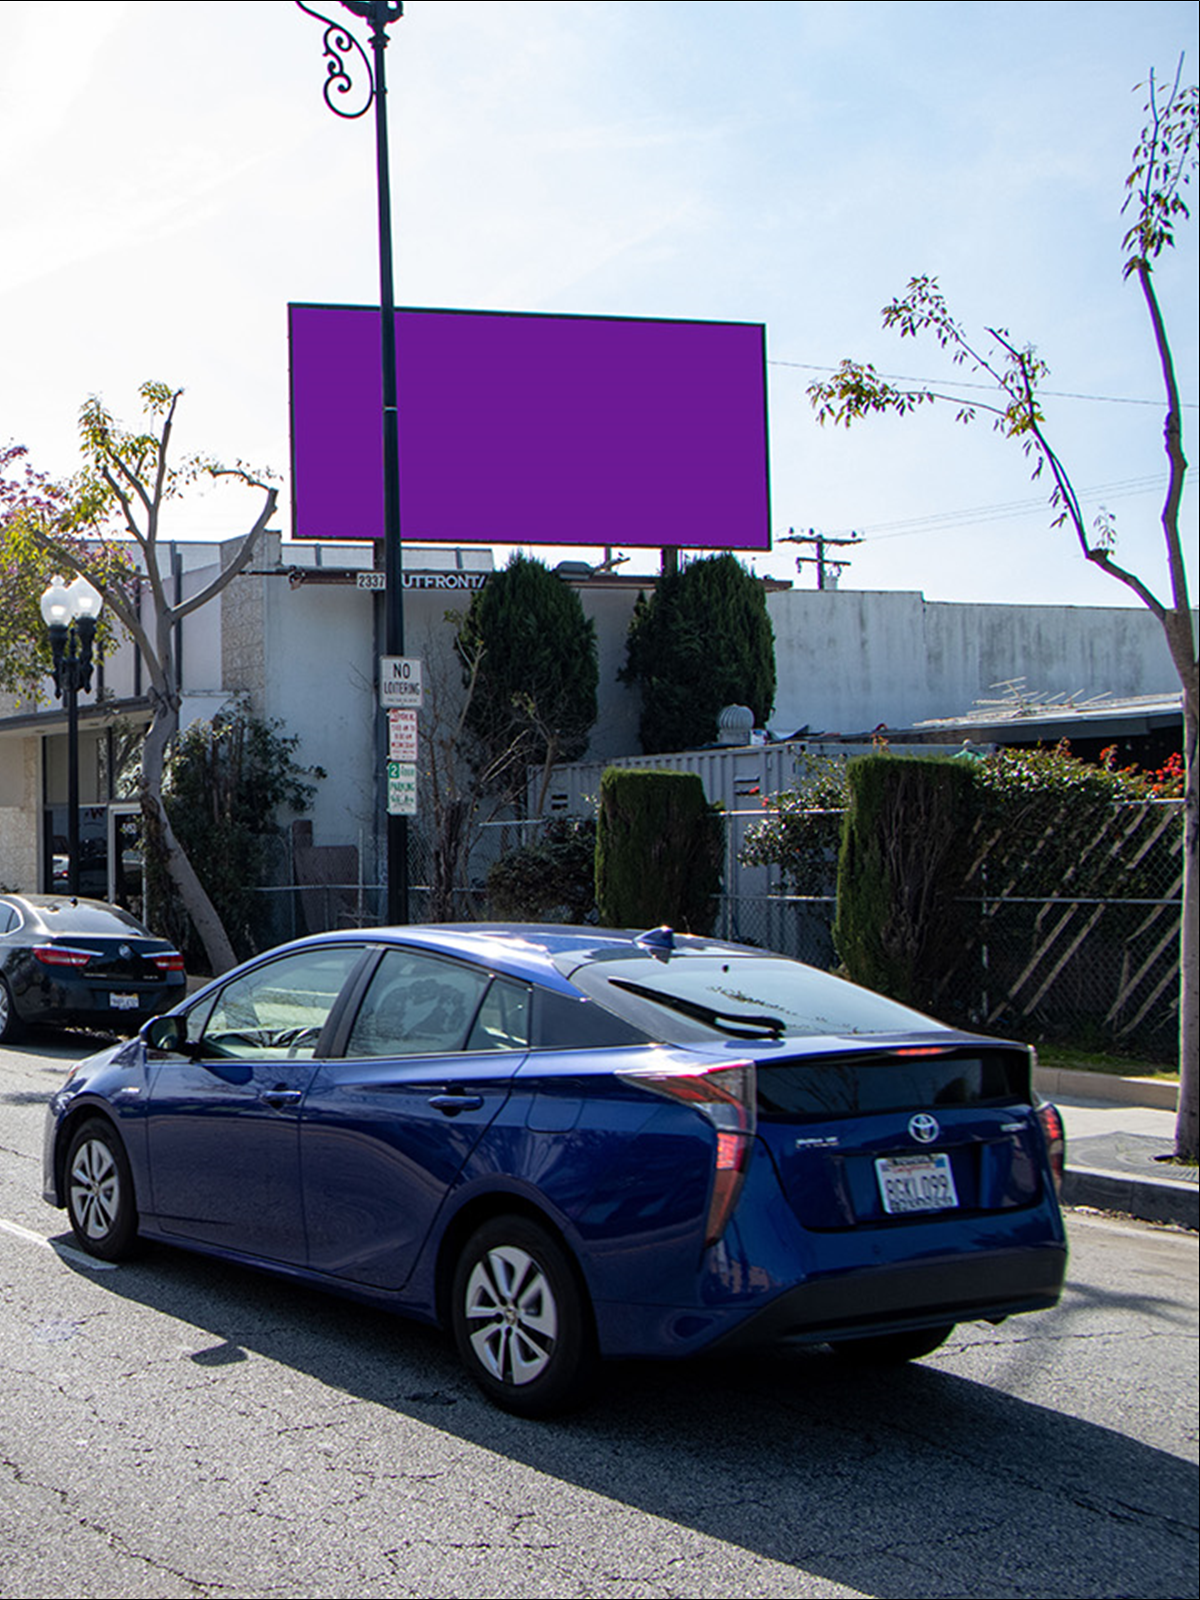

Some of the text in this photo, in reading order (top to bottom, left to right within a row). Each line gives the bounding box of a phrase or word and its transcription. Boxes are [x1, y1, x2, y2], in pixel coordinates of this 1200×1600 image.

[359, 575, 385, 587] 2337
[401, 574, 486, 589] UTFRONT/
[393, 663, 410, 679] NO
[384, 681, 420, 695] LOITERING
[391, 765, 398, 777] 2
